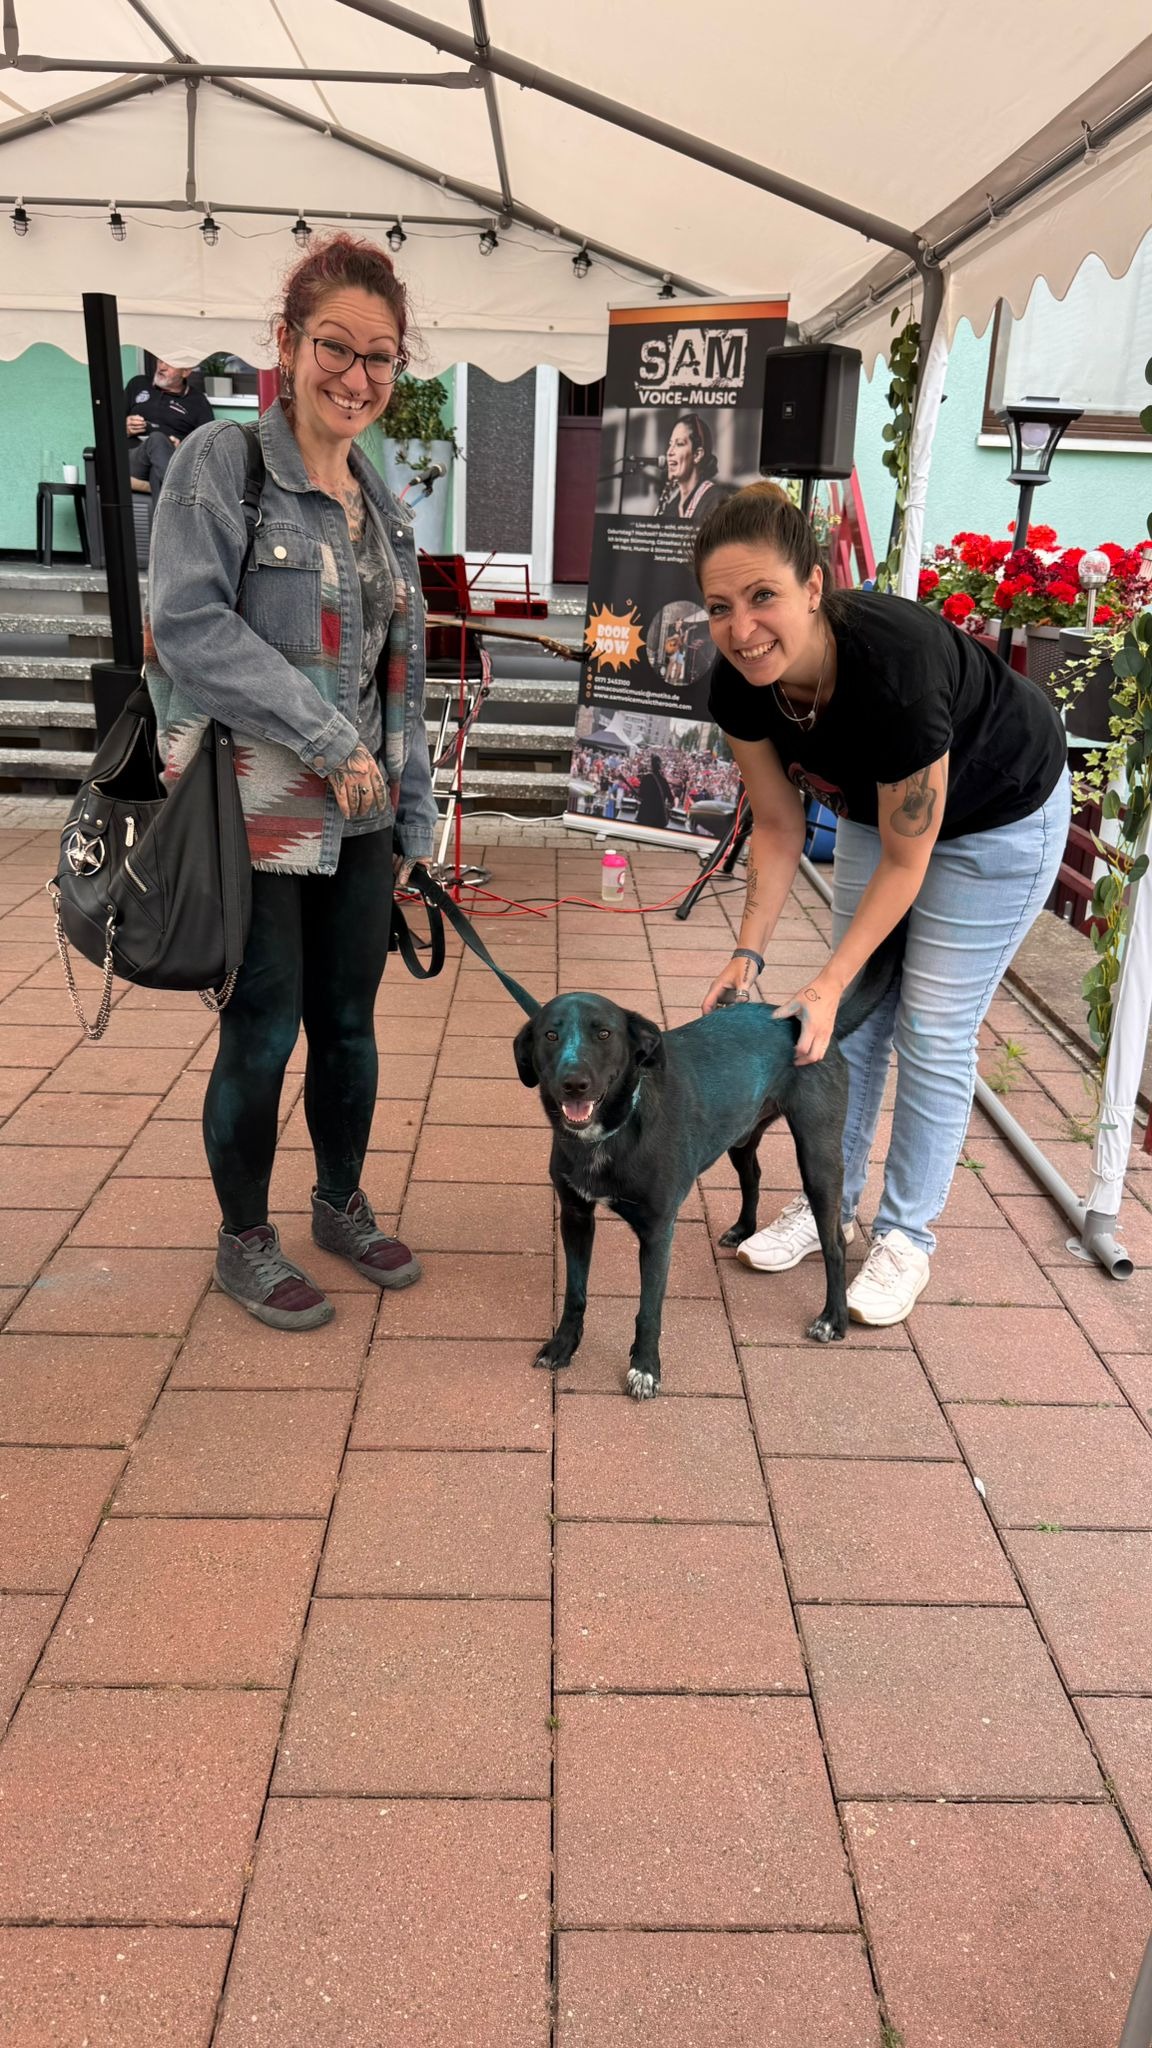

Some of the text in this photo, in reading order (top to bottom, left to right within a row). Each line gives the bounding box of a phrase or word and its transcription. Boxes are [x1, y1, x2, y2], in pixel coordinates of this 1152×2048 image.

[637, 328, 748, 389] SAM
[639, 391, 737, 405] VOICE-MUSIC
[597, 624, 630, 640] BOOK
[595, 637, 629, 655] NOW
